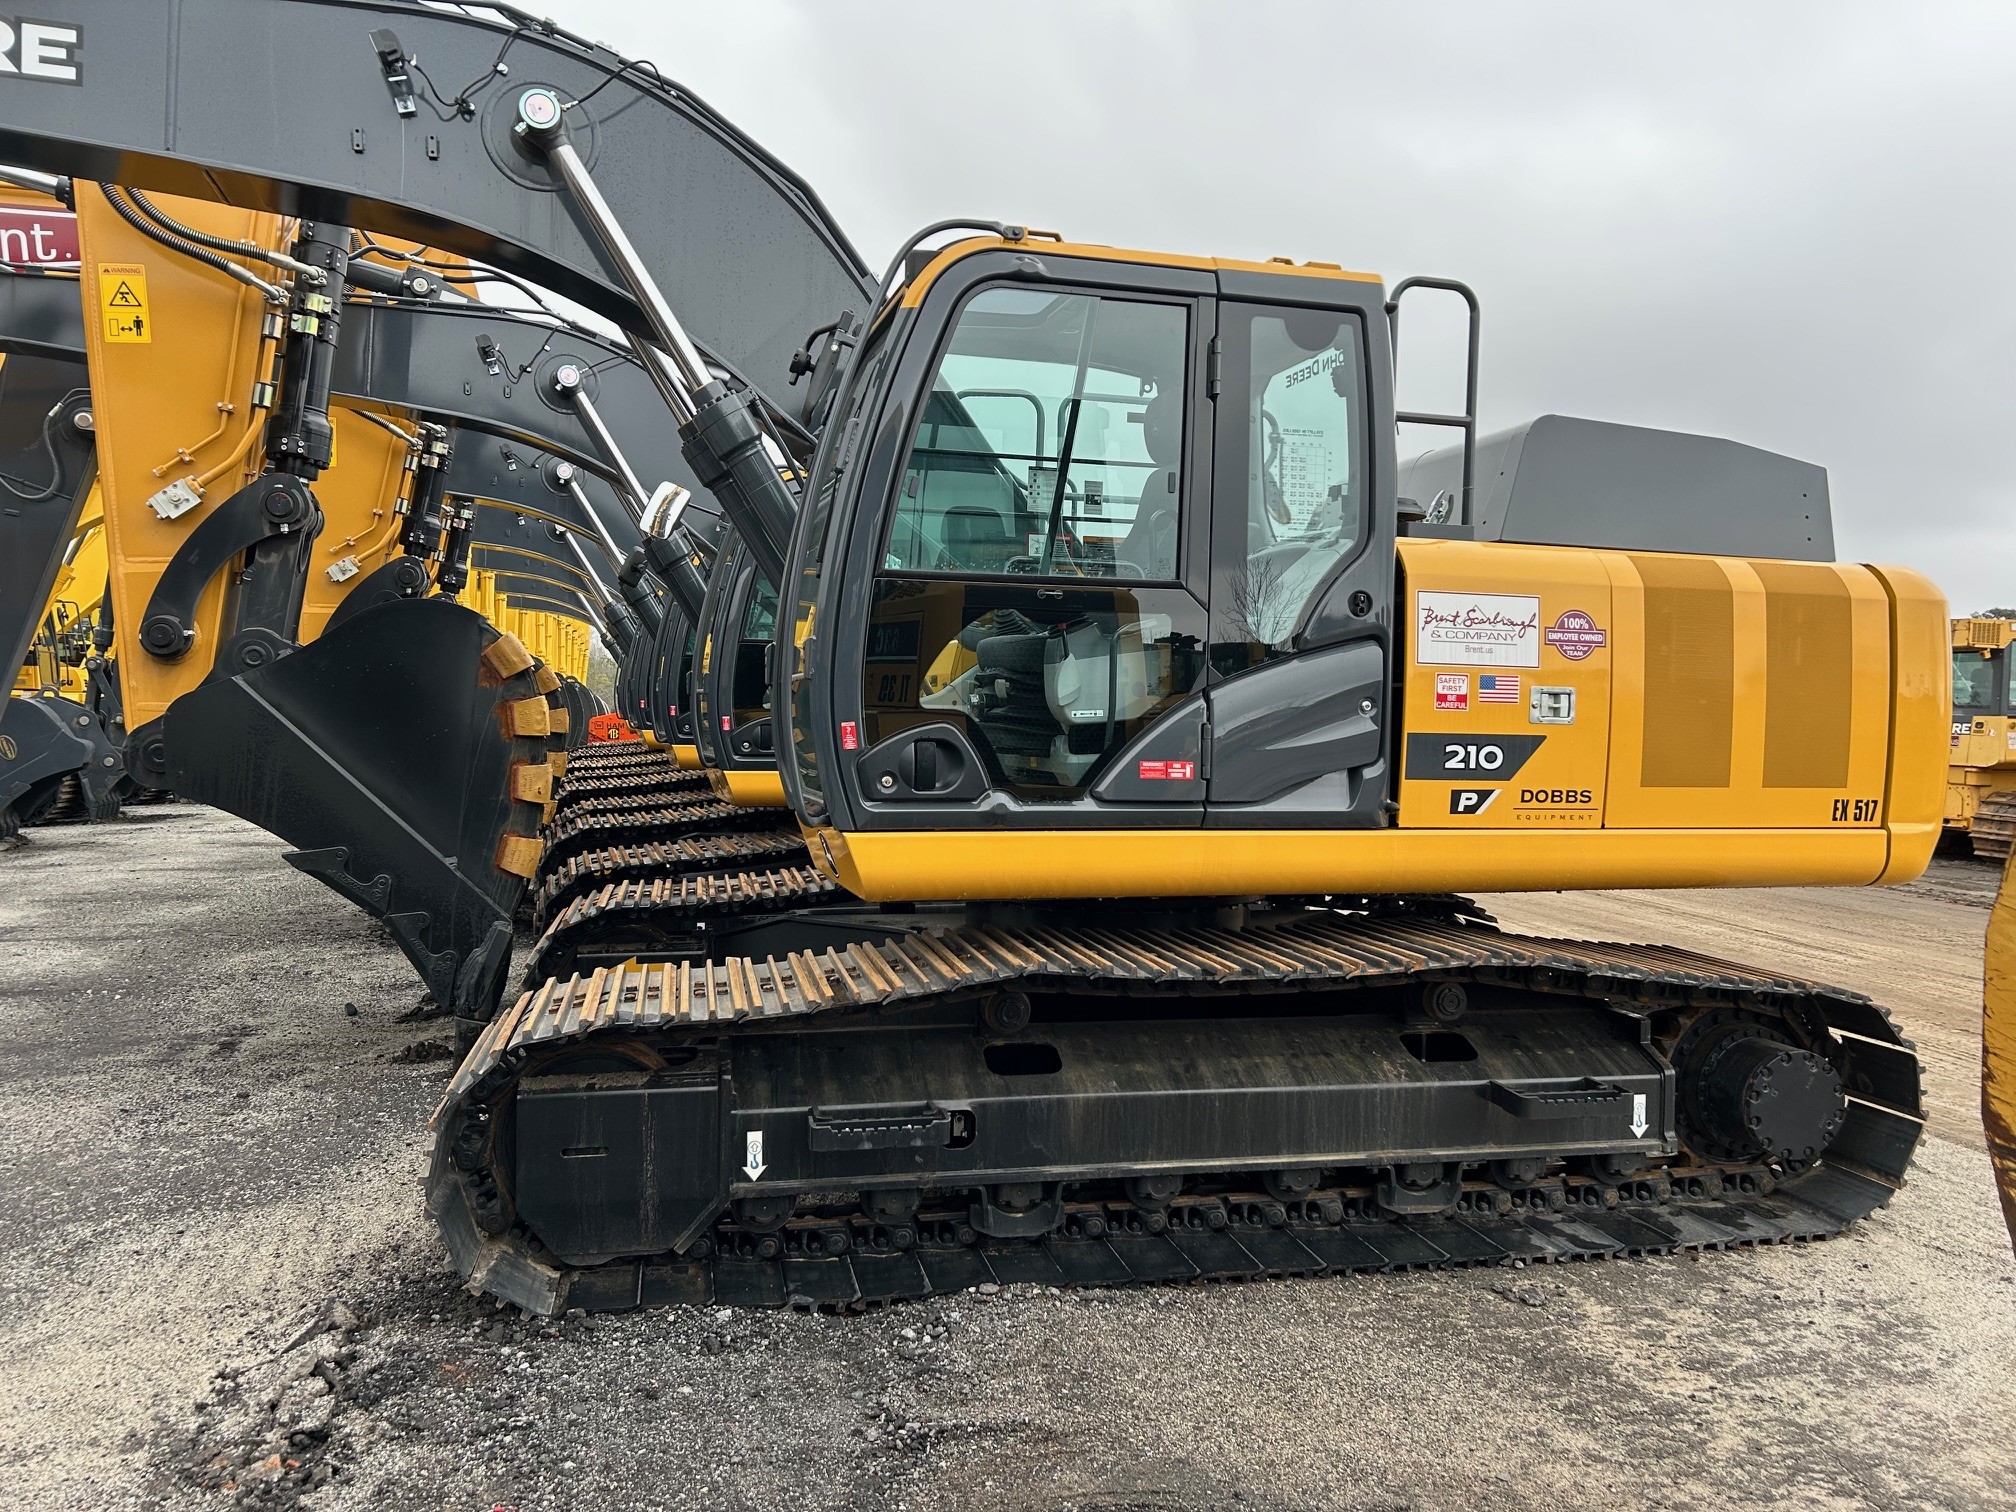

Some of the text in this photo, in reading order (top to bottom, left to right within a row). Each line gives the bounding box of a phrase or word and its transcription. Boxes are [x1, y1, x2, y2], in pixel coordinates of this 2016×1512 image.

[1421, 606, 1537, 639] Brent Scarbrough
[1563, 617, 1589, 630] 100%
[1431, 629, 1517, 641] & COMPANY
[1548, 632, 1603, 642] EMPLOYEE OWNED
[1465, 645, 1493, 654] Brent.us
[1438, 677, 1466, 685] SAFETY
[1446, 694, 1458, 702] BE
[1436, 701, 1467, 709] CAREFUL
[1444, 744, 1504, 770] 210
[1520, 789, 1592, 804] DOBBS
[1832, 799, 1879, 822] EX 517
